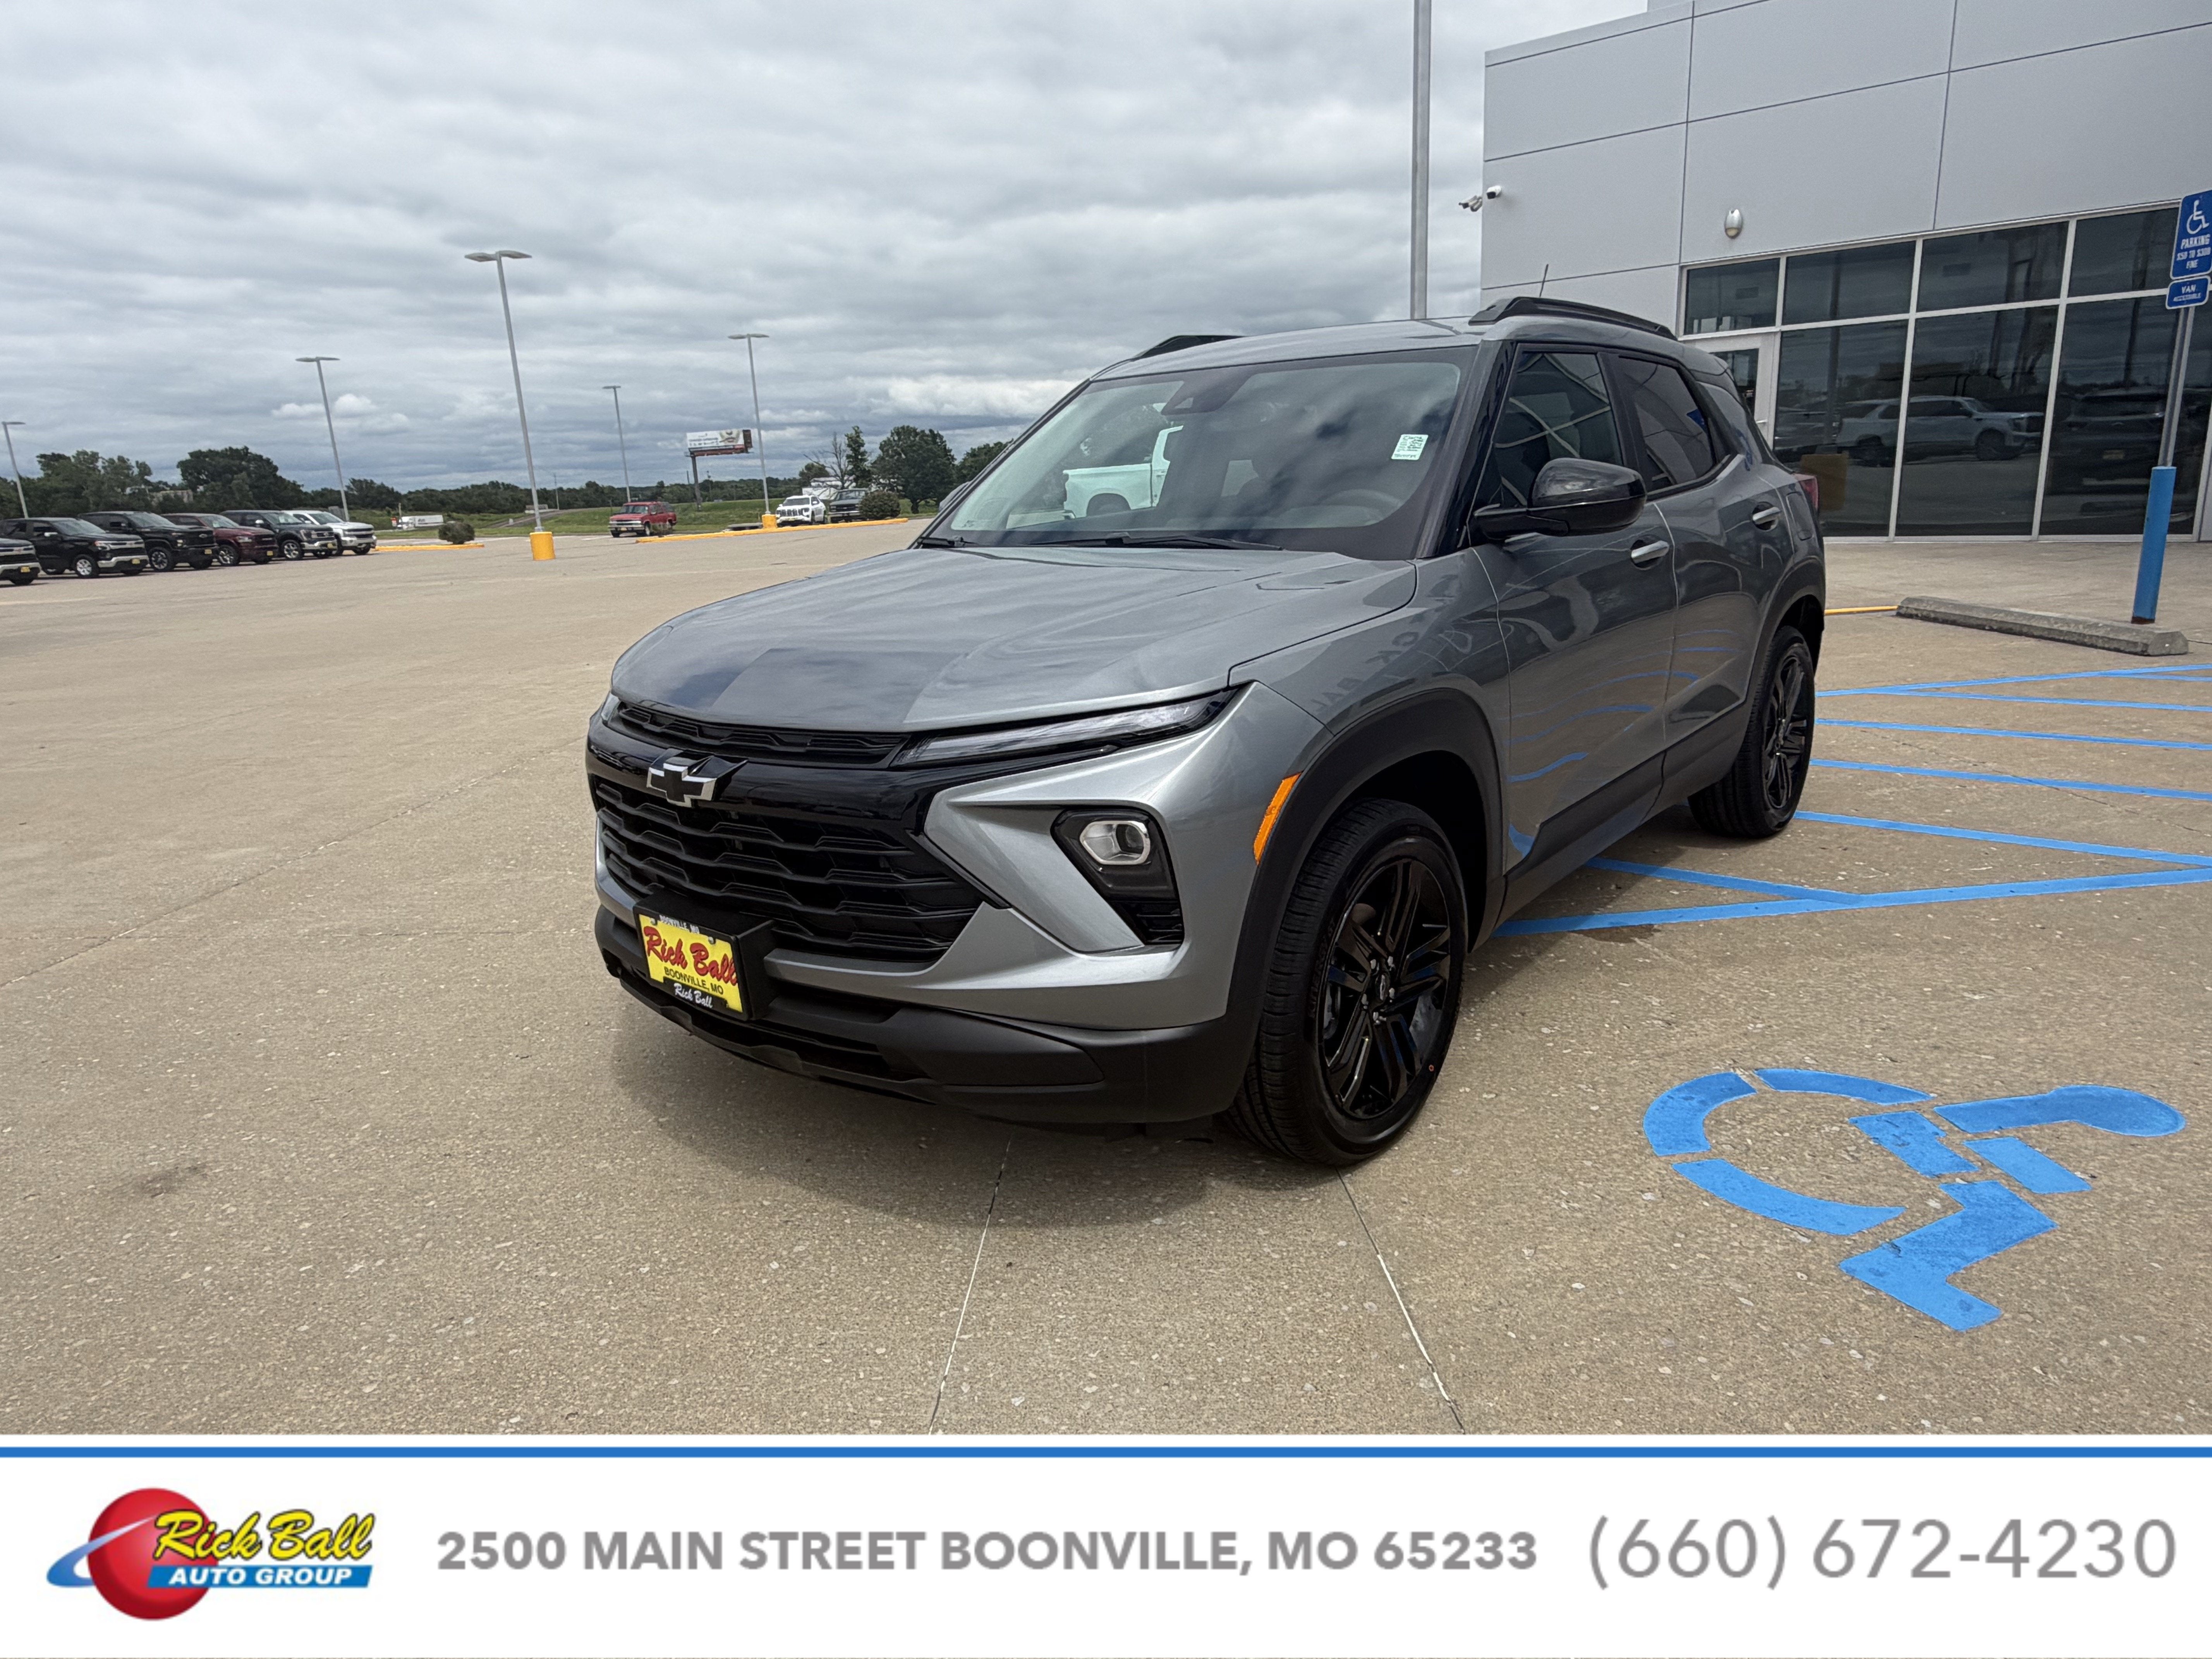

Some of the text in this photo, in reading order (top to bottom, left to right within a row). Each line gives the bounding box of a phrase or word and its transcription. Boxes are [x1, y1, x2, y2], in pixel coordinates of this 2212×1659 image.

[2181, 234, 2210, 249] PARKING
[2182, 285, 2196, 294] VAN
[644, 926, 738, 986] Rick Ball
[664, 966, 723, 994] BOONVILLE, MO
[674, 983, 713, 1008] Rick Ball
